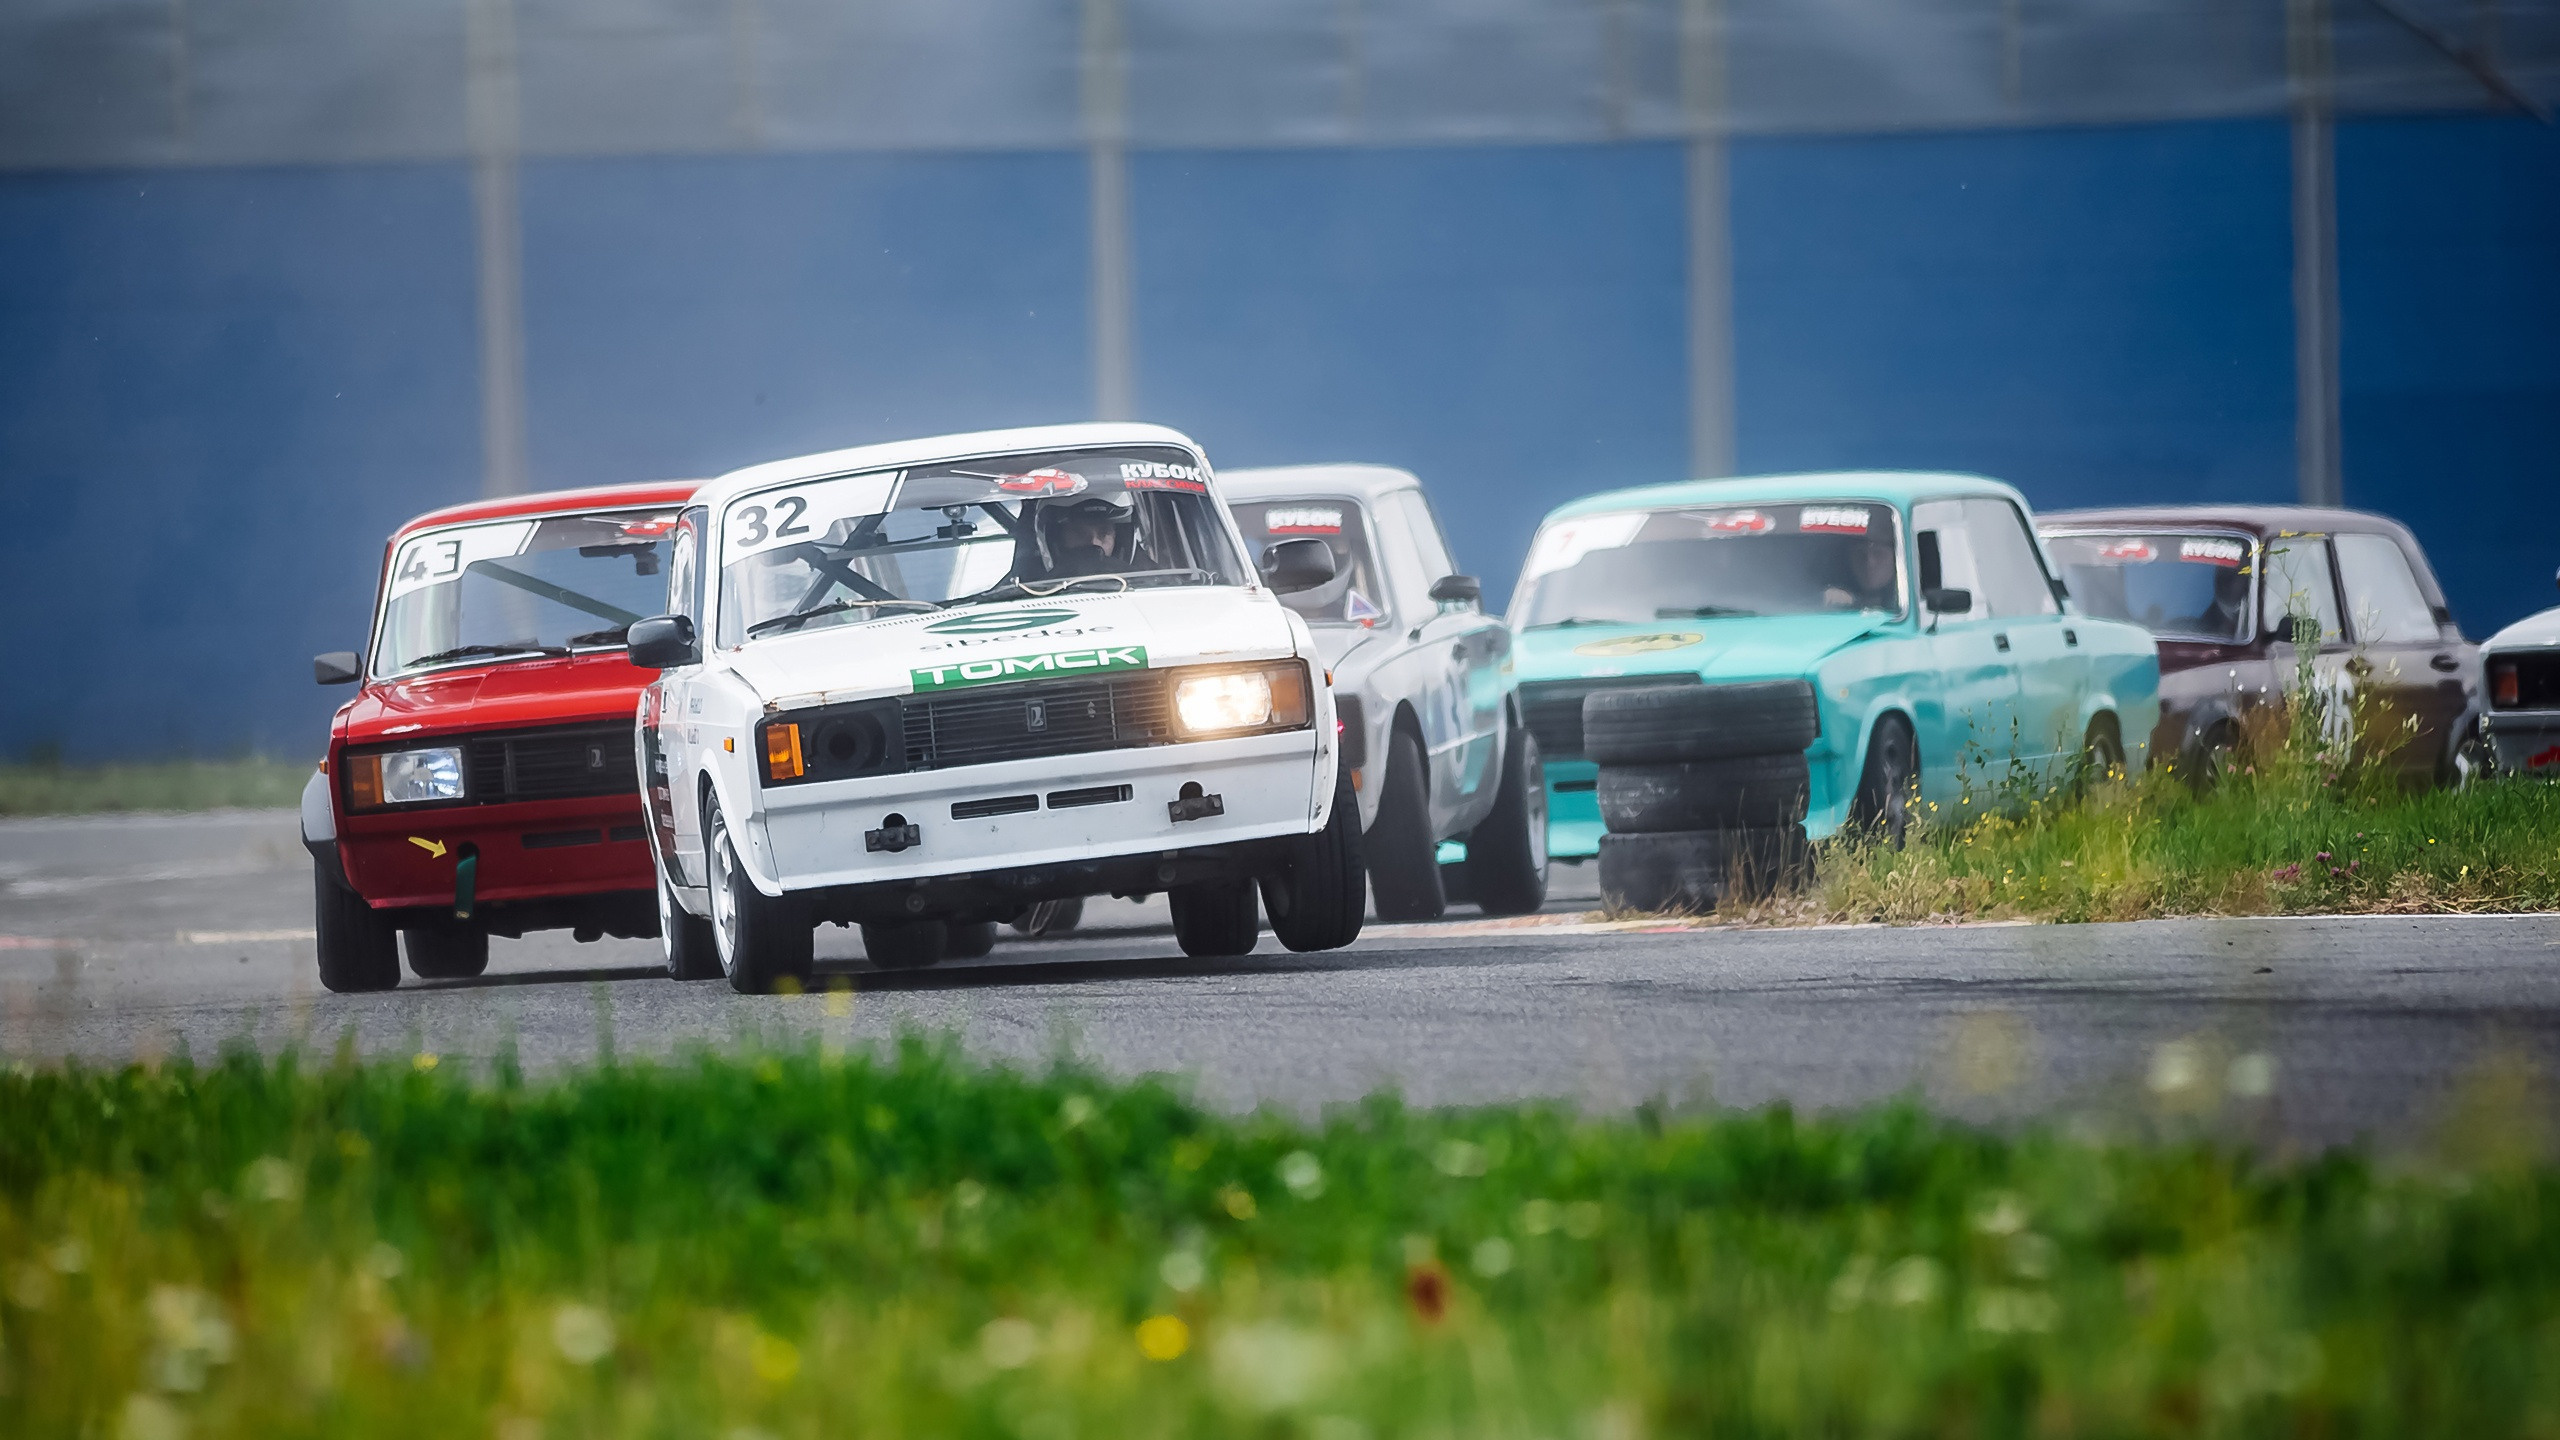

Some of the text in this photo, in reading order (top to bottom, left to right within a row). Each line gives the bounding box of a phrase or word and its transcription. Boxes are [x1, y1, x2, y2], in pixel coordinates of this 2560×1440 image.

[1120, 463, 1204, 482] КУБОК
[736, 496, 810, 547] 32
[398, 540, 463, 582] 43
